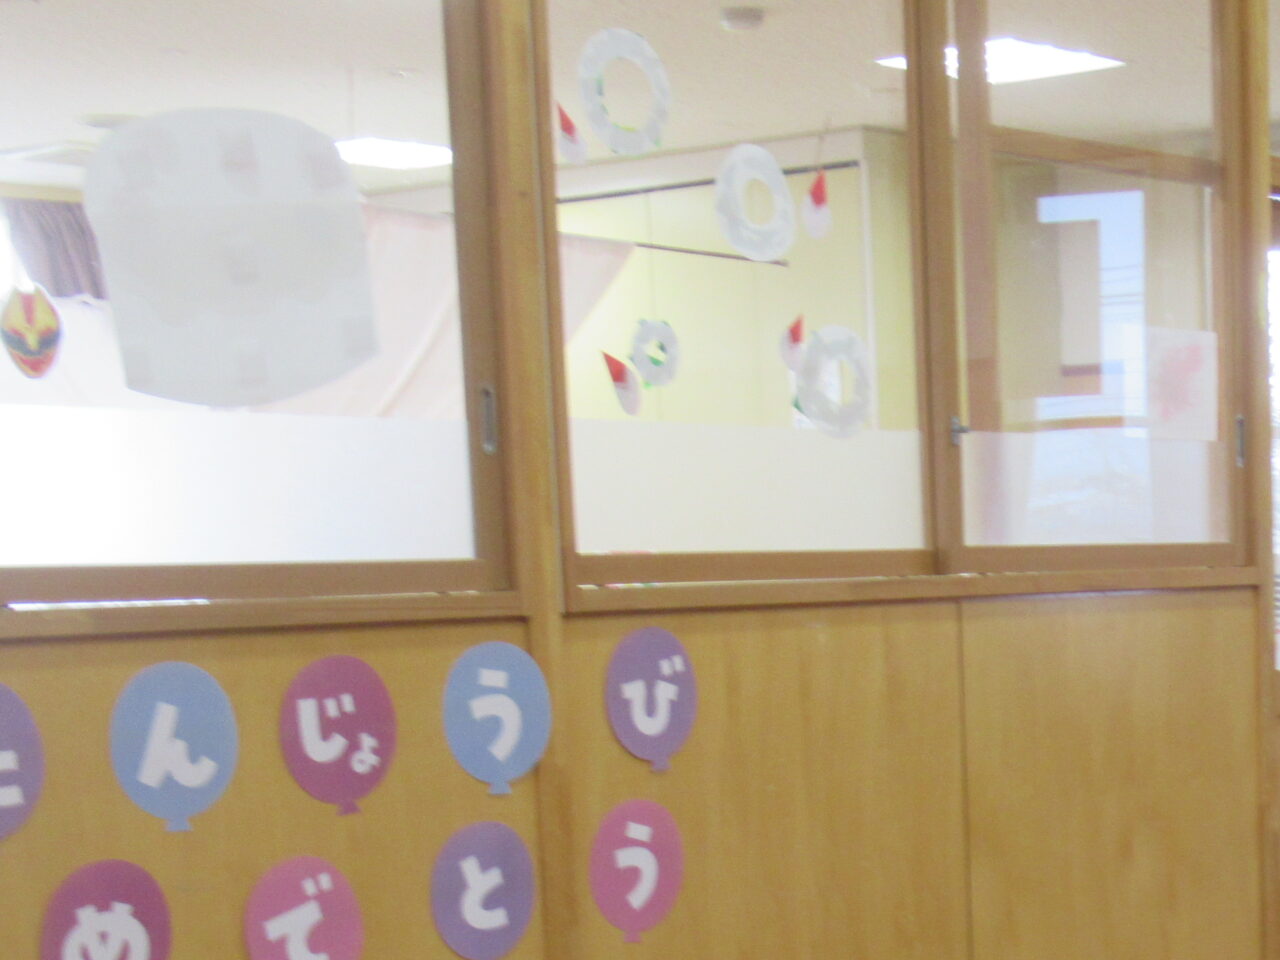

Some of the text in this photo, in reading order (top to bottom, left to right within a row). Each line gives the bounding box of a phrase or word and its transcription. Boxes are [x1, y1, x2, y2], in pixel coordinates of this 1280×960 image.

[0, 655, 686, 807] んじょうび
